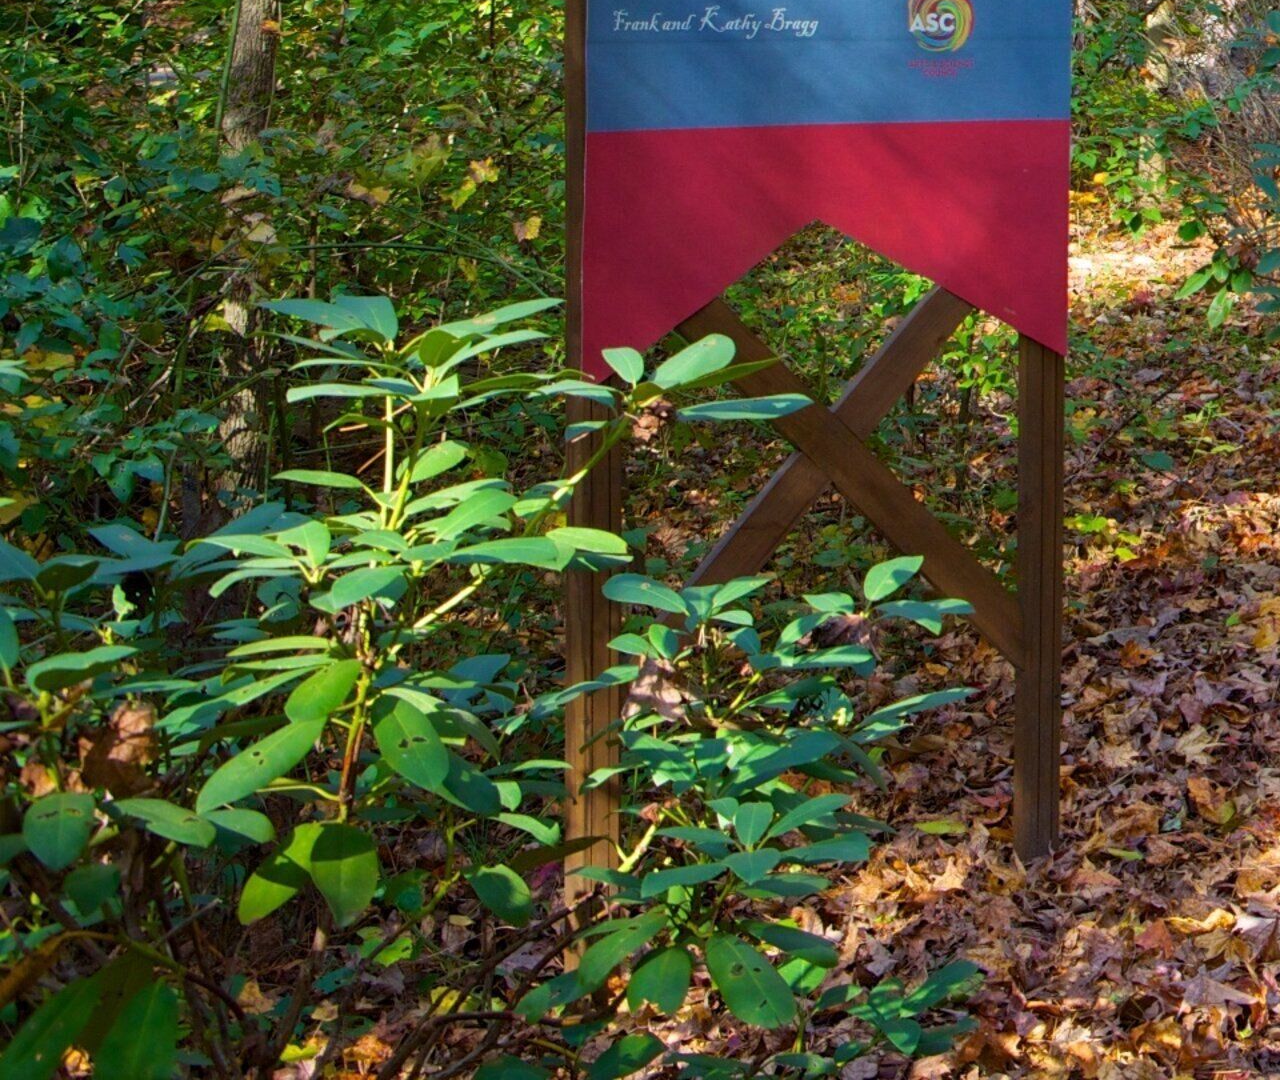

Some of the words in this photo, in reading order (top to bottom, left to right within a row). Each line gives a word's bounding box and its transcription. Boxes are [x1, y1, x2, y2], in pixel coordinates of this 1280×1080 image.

[613, 8, 661, 31] Frank
[662, 13, 696, 31] and
[699, 5, 761, 39] Kathy
[764, 7, 819, 36] Bragg
[909, 12, 956, 33] ASC
